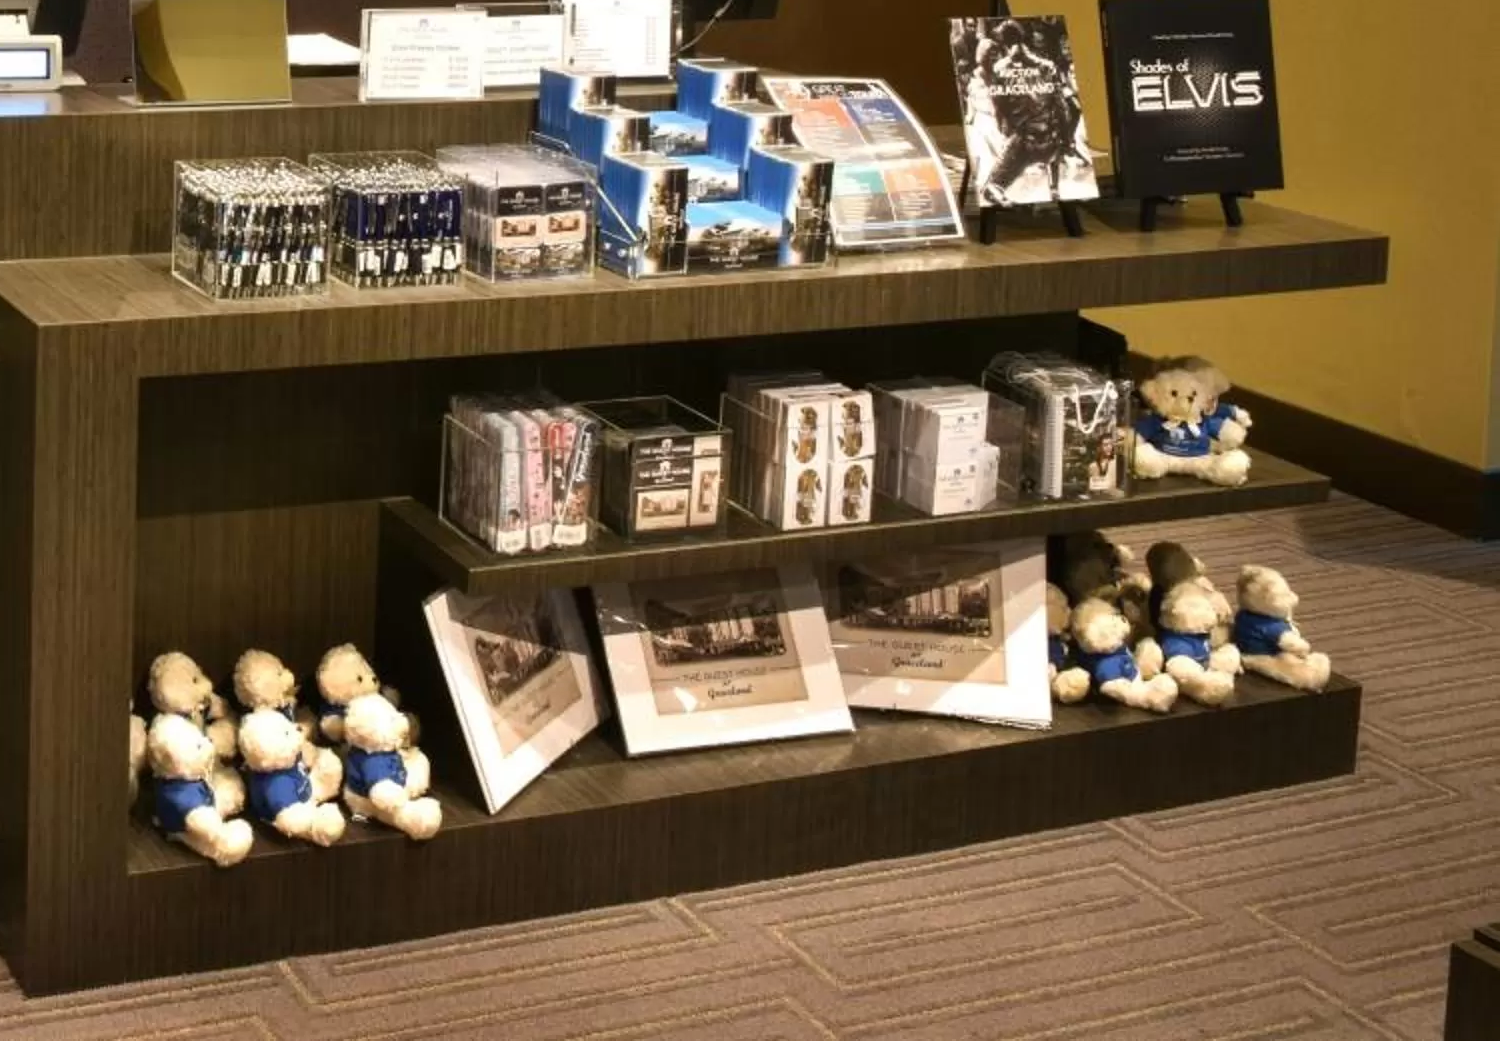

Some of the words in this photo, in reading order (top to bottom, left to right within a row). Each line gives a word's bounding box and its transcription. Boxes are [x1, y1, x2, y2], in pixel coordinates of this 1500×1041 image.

[1129, 58, 1173, 74] Shades
[1175, 57, 1190, 72] of
[1131, 71, 1264, 111] ELVIS
